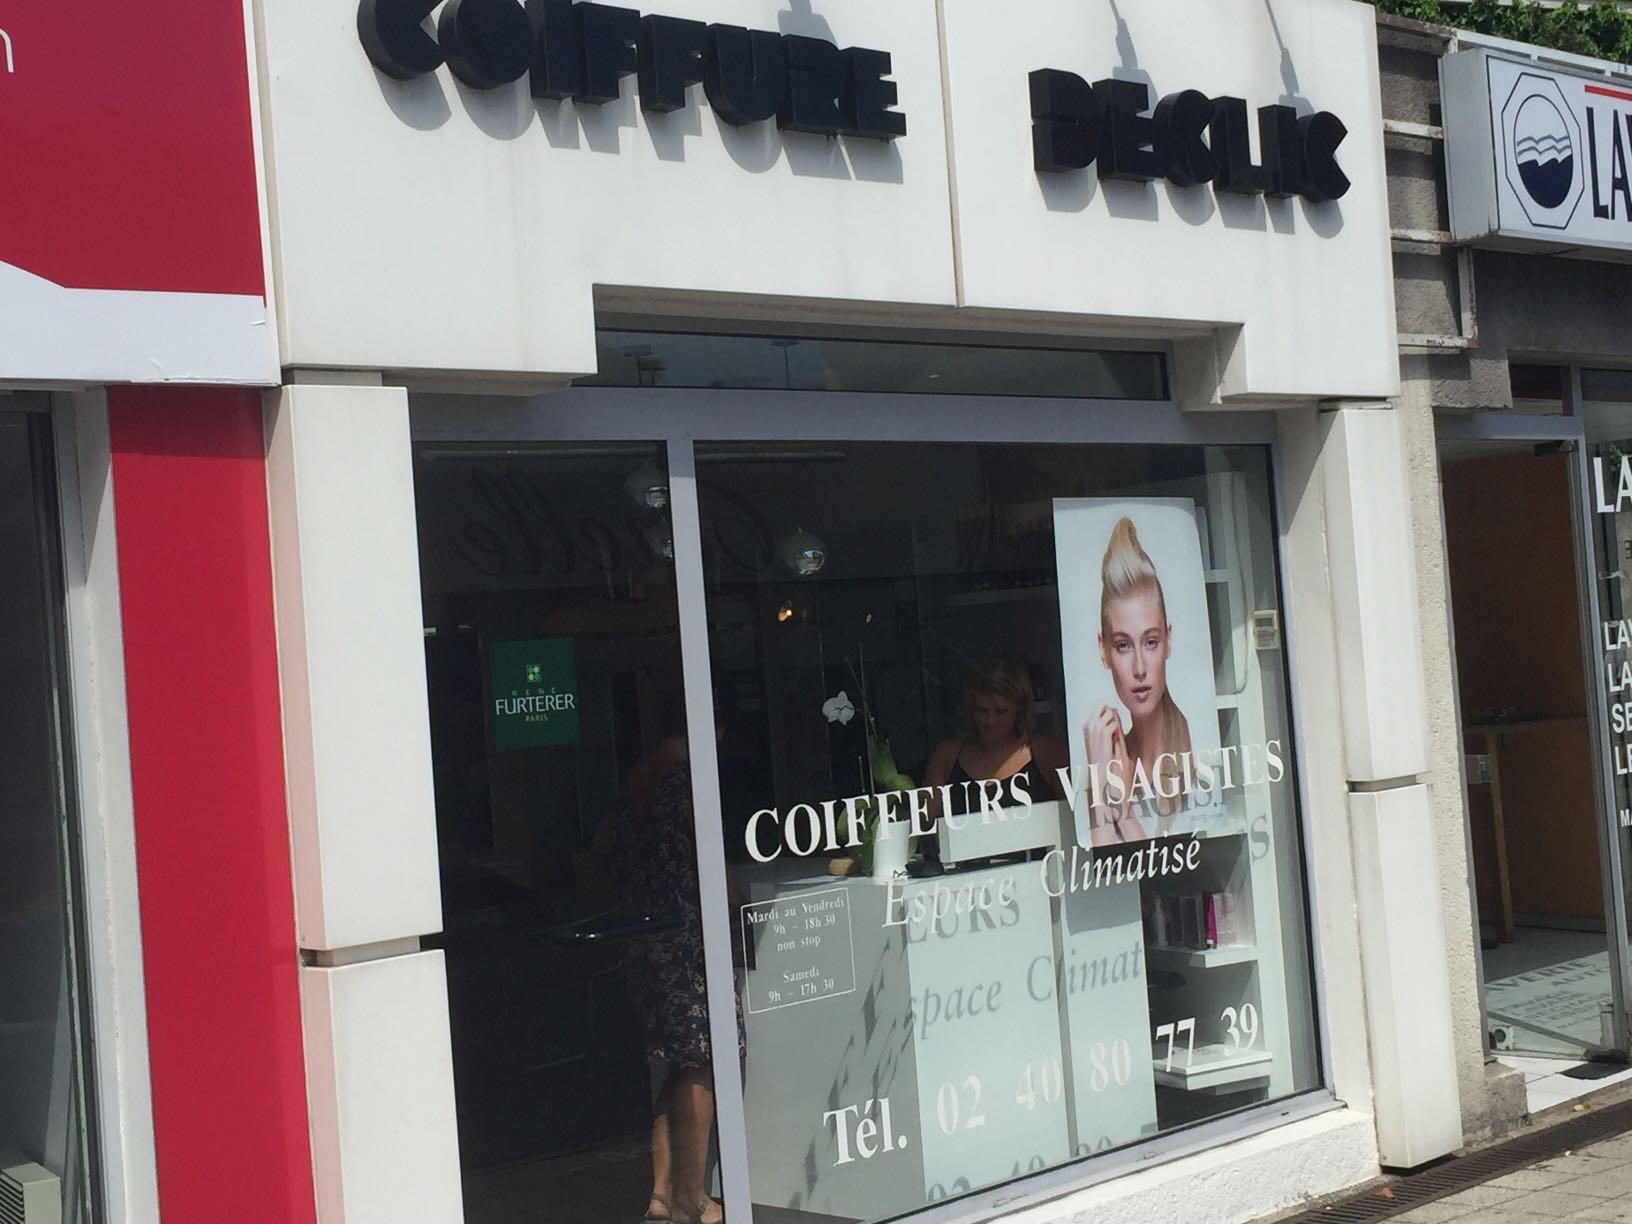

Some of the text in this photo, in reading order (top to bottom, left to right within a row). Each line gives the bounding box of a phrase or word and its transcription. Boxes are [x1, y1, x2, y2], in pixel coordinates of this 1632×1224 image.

[357, 0, 907, 139] COIFFURE
[1586, 106, 1632, 222] LA
[1604, 619, 1632, 650] LA
[495, 693, 576, 715] FURTERER
[525, 713, 549, 722] PARIS
[745, 771, 1033, 863] COIFFEURS
[1056, 739, 1285, 812] VISAGISTES
[881, 874, 1015, 935] Espace
[1040, 828, 1201, 898] Climatisé
[747, 896, 845, 925] Mardi au Vendredi
[773, 923, 786, 936] 9h
[804, 916, 822, 930] 18h
[824, 913, 836, 927] 30
[777, 935, 821, 952] non stop
[783, 965, 820, 984] Samedi
[768, 990, 782, 1003] 9h
[800, 982, 818, 996] 17h
[823, 977, 835, 991] 30
[823, 1003, 1259, 1167] Tél. 02 40 80 77 39
